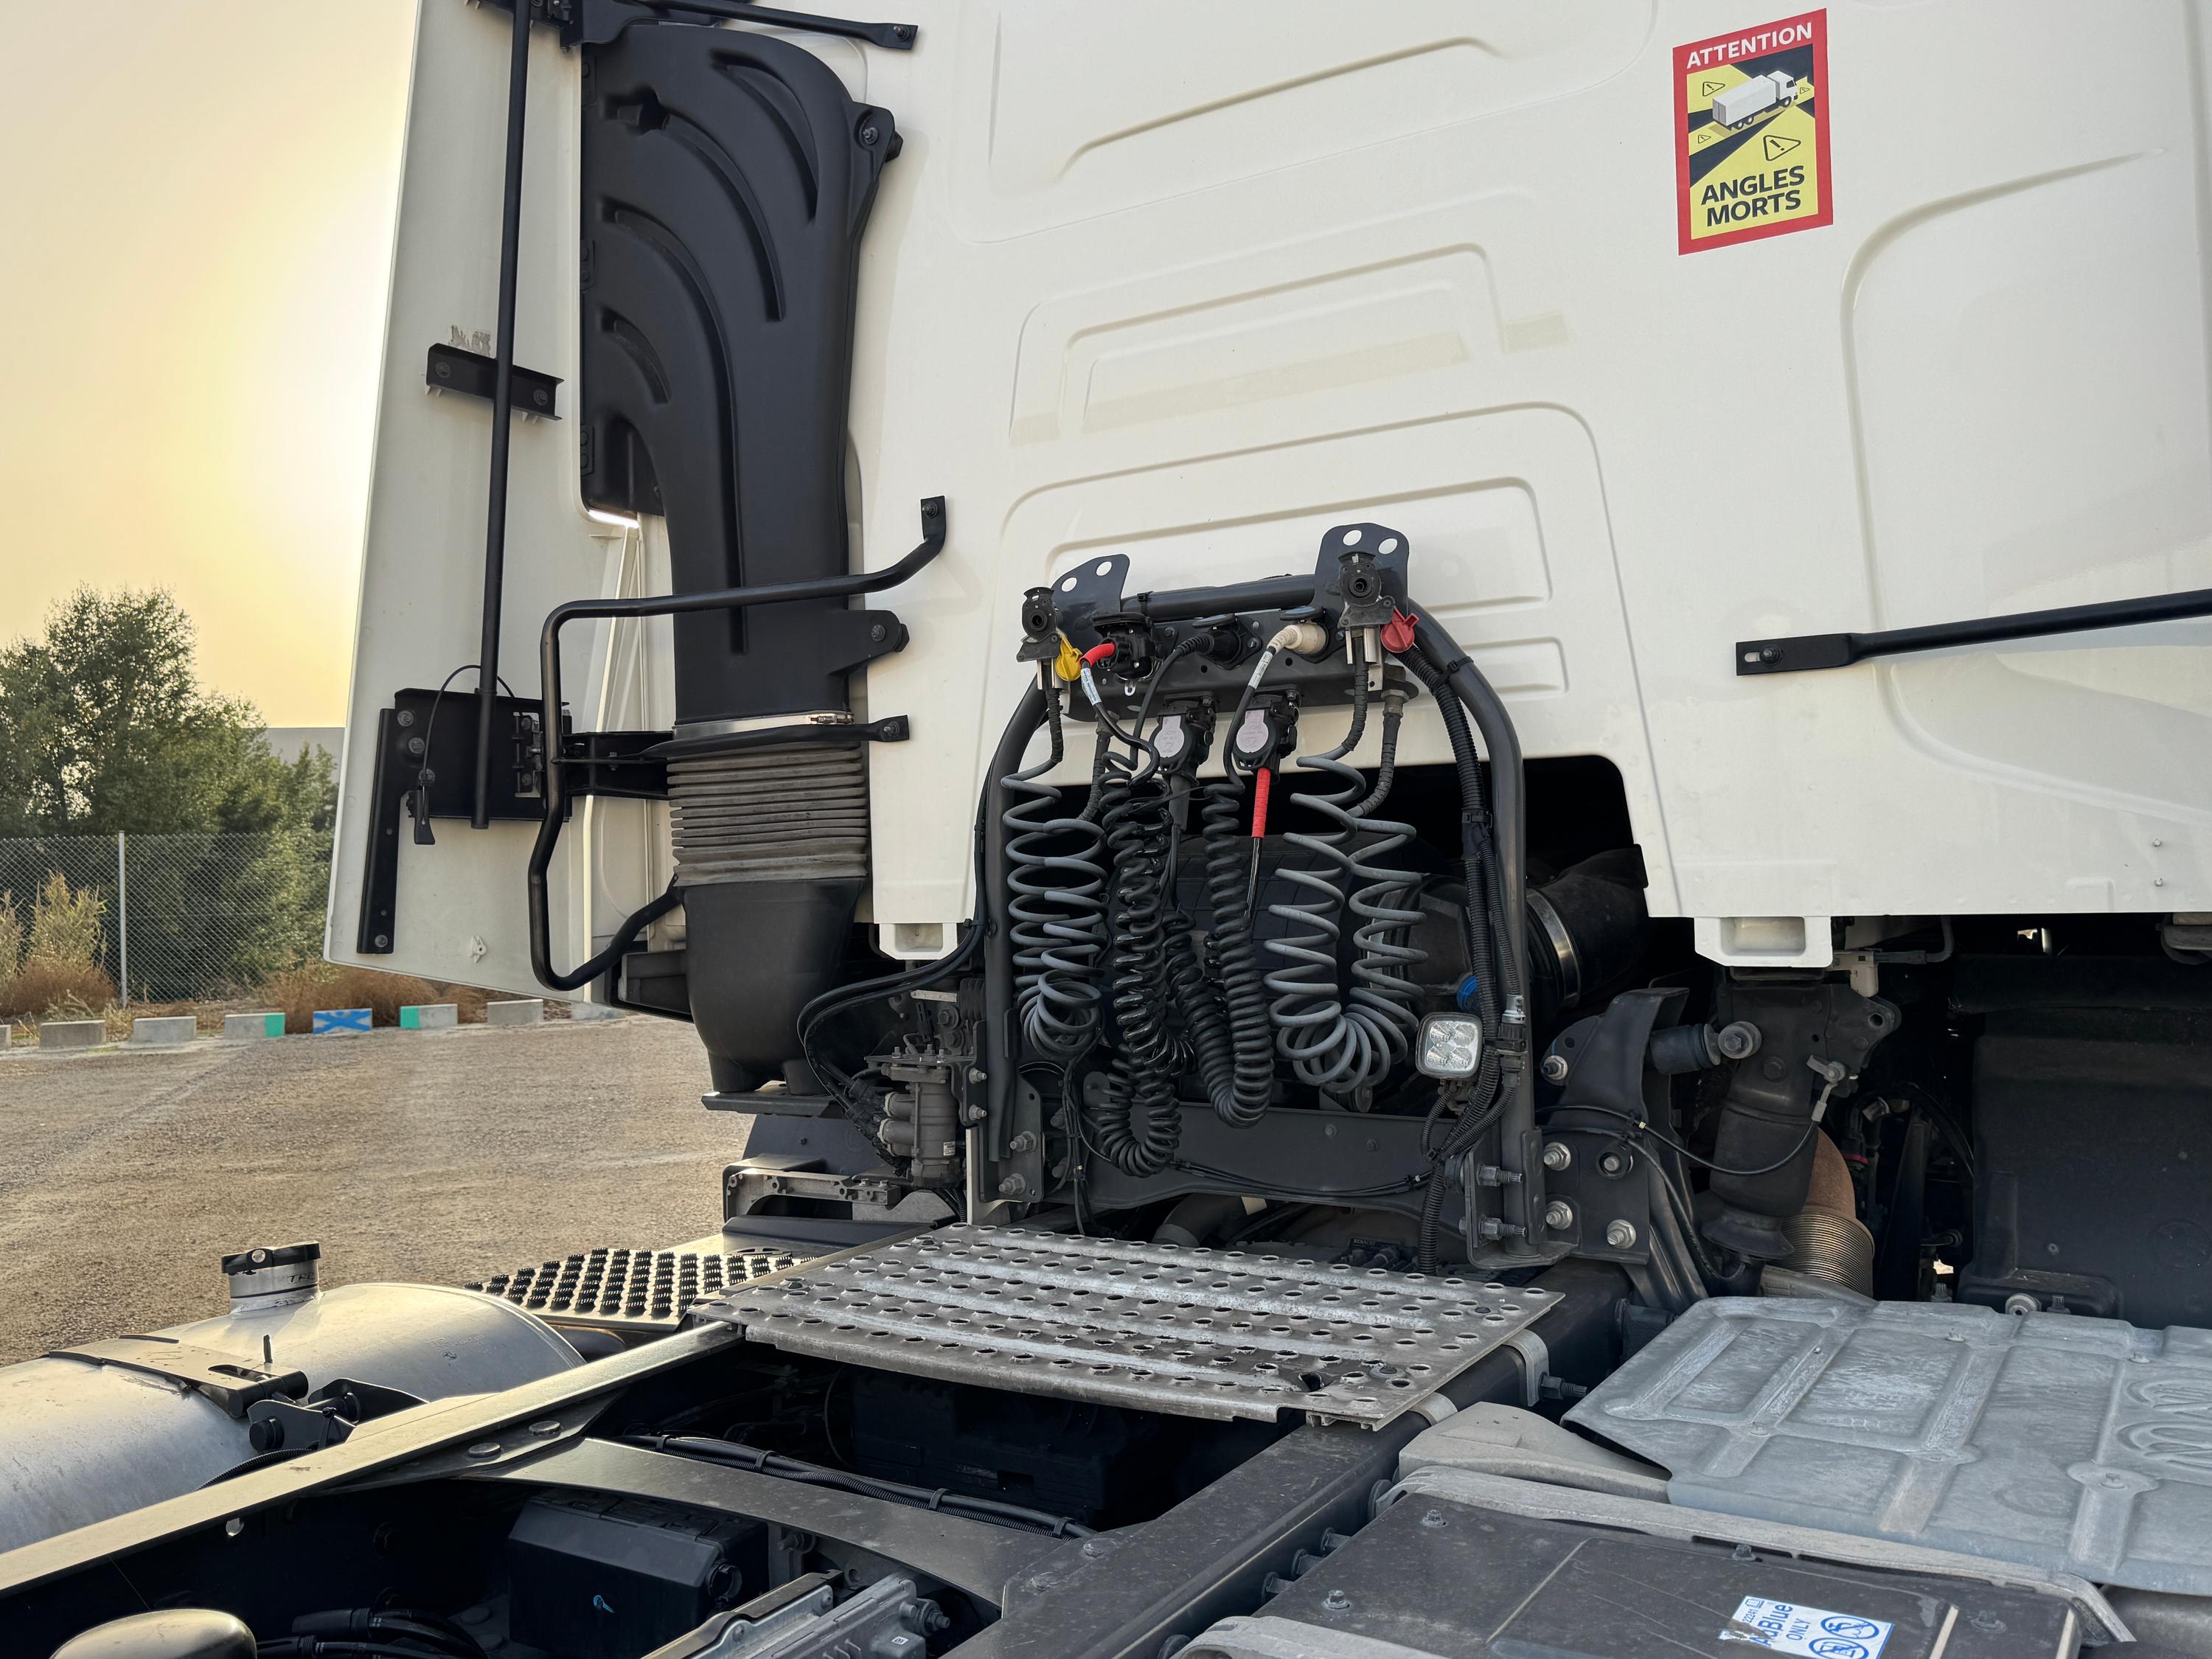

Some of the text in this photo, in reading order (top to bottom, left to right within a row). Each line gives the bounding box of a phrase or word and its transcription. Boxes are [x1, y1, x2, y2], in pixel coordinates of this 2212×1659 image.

[1686, 21, 1812, 69] ATTENTION
[1701, 165, 1805, 205] ANGLES
[1706, 189, 1801, 227] MORTS
[1786, 1618, 1811, 1641] ONLY
